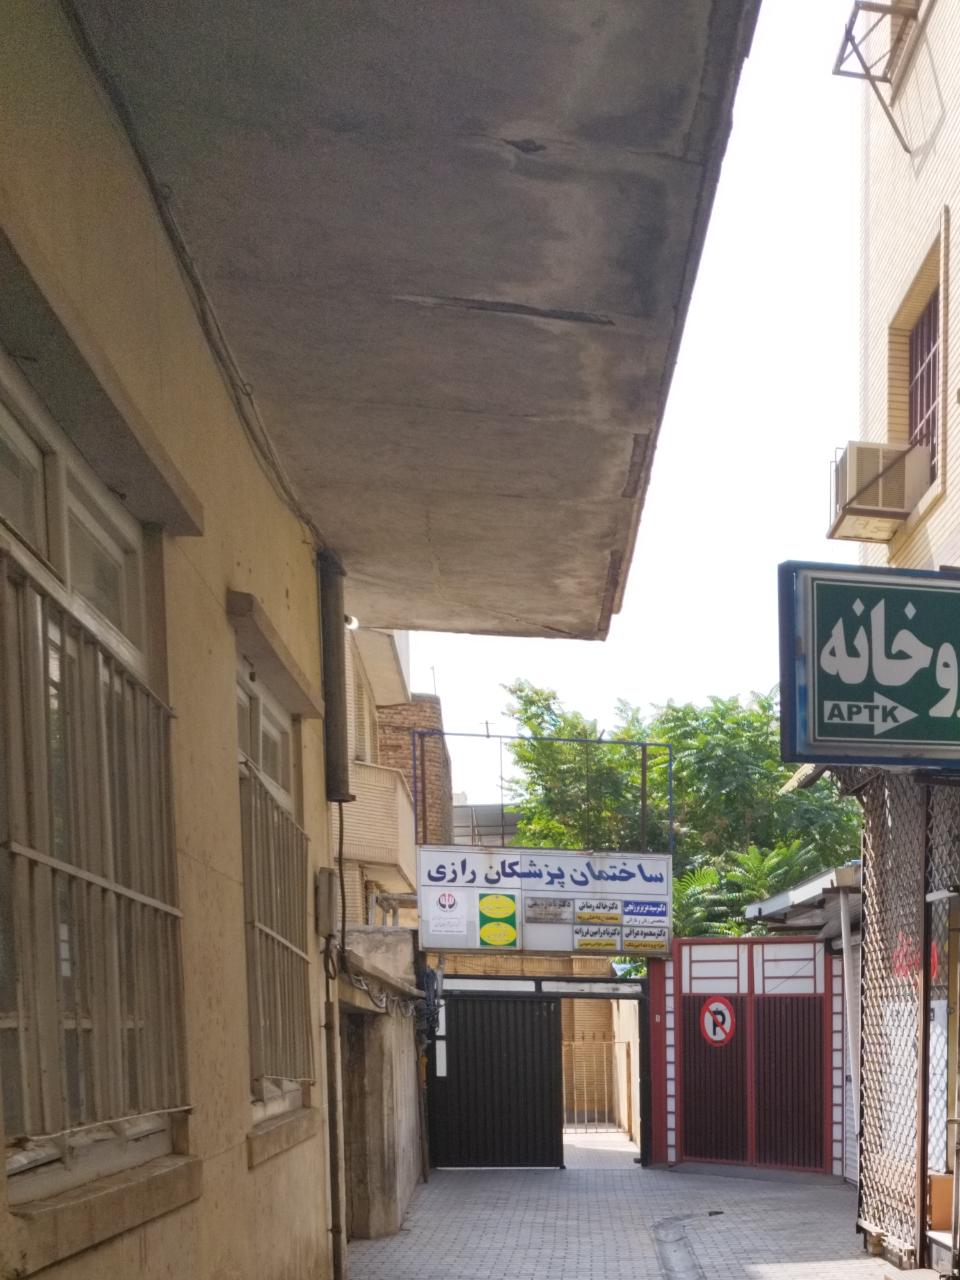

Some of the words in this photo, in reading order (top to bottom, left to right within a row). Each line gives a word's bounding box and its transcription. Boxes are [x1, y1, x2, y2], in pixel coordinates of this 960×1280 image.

[827, 703, 900, 723] APTK
[427, 858, 477, 884] رازی
[484, 859, 564, 888] پزشکان
[570, 860, 665, 887] ساختمان
